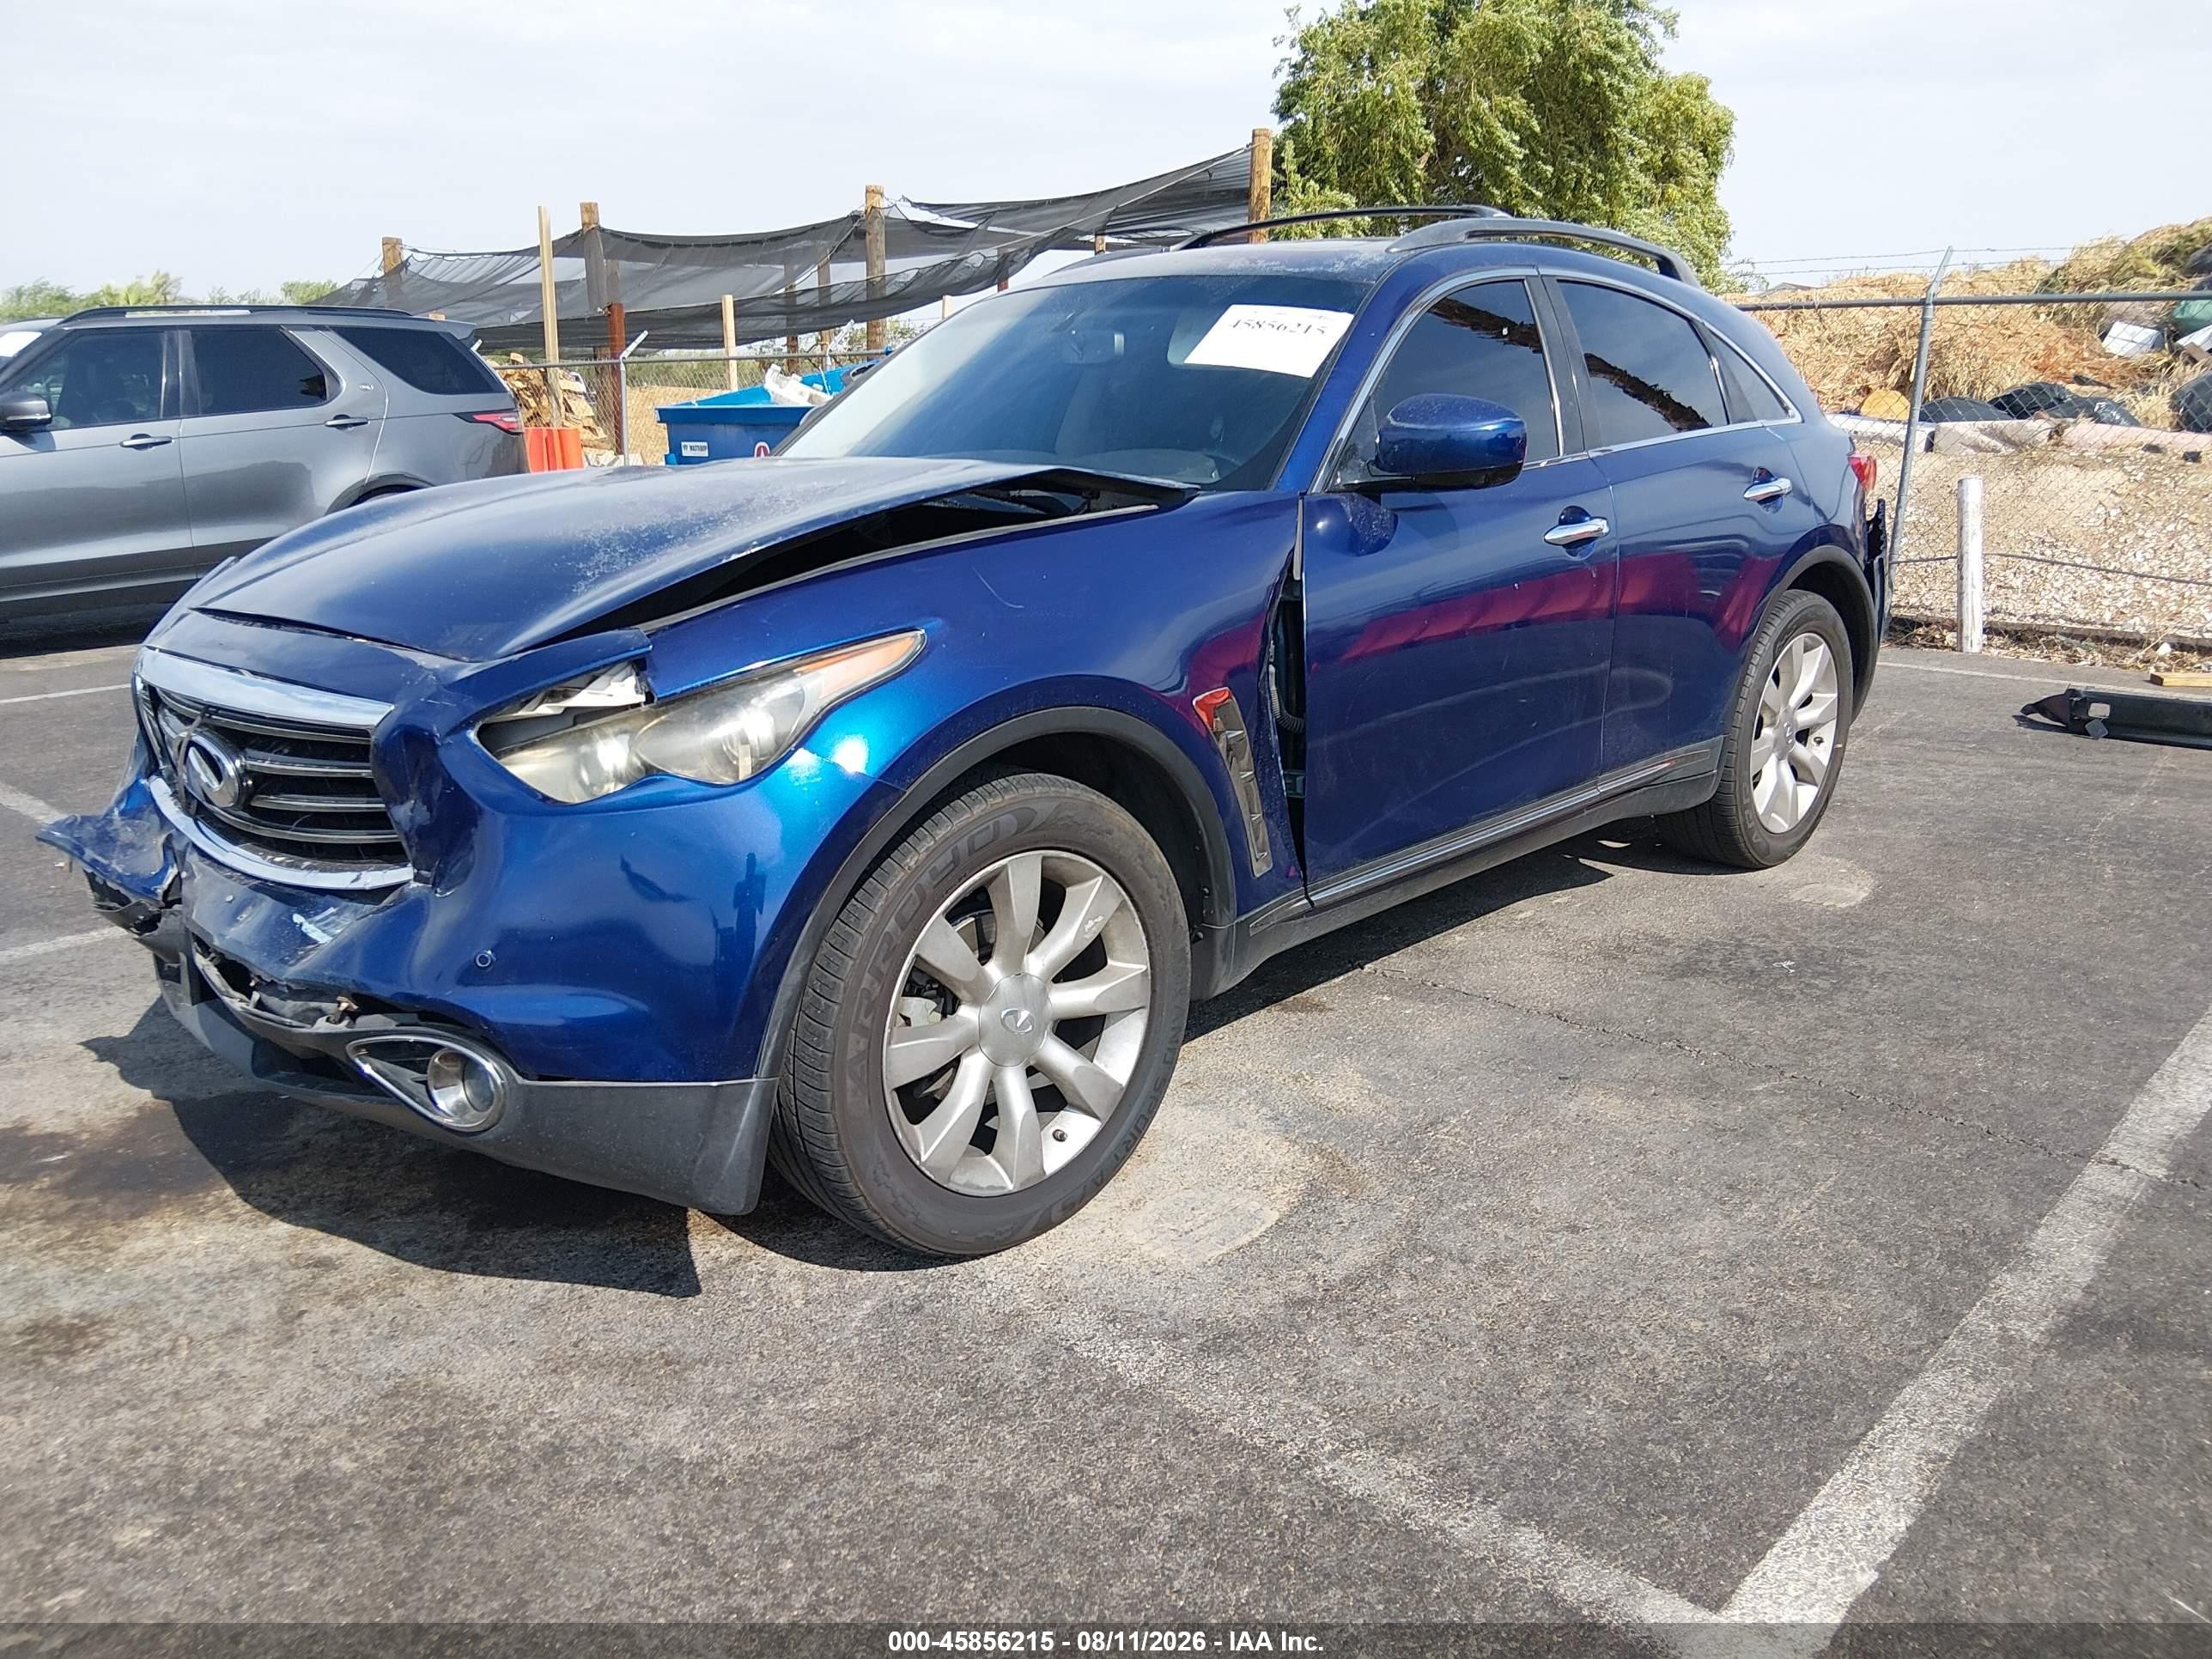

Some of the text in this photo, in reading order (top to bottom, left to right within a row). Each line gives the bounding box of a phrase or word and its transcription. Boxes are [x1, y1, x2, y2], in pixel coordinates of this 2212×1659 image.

[1231, 319, 1327, 335] 45856215
[847, 819, 1002, 1087] ARROYO
[1113, 1076, 1167, 1162] SPORT
